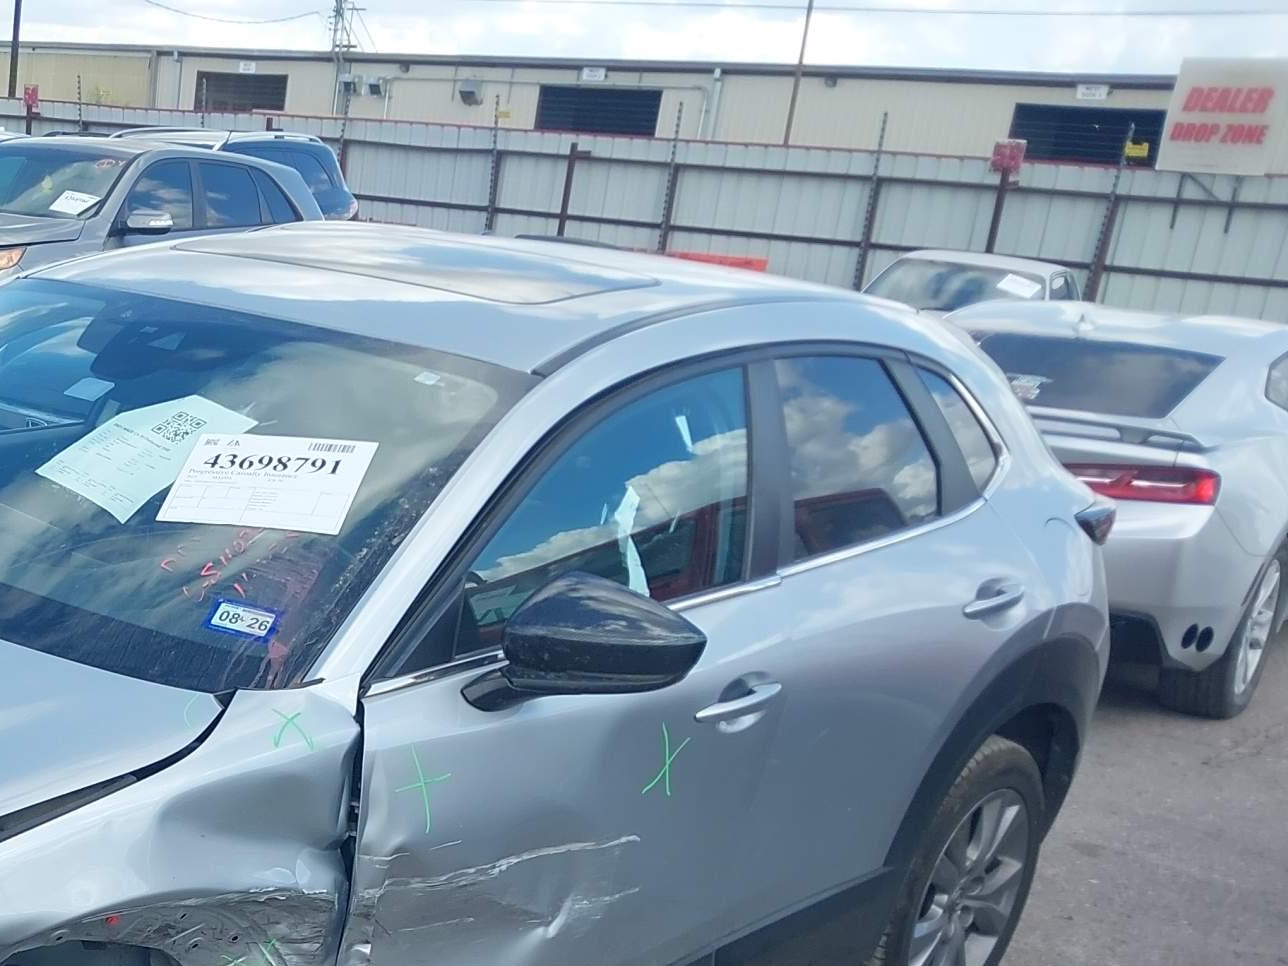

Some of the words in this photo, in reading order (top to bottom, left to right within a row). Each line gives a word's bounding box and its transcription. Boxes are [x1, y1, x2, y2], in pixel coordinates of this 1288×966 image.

[1182, 87, 1274, 113] DEALER
[1170, 122, 1221, 142] DROP
[1219, 123, 1270, 144] ZONE
[203, 453, 343, 475] 43698791
[218, 610, 240, 625] 08
[246, 617, 270, 632] 26
